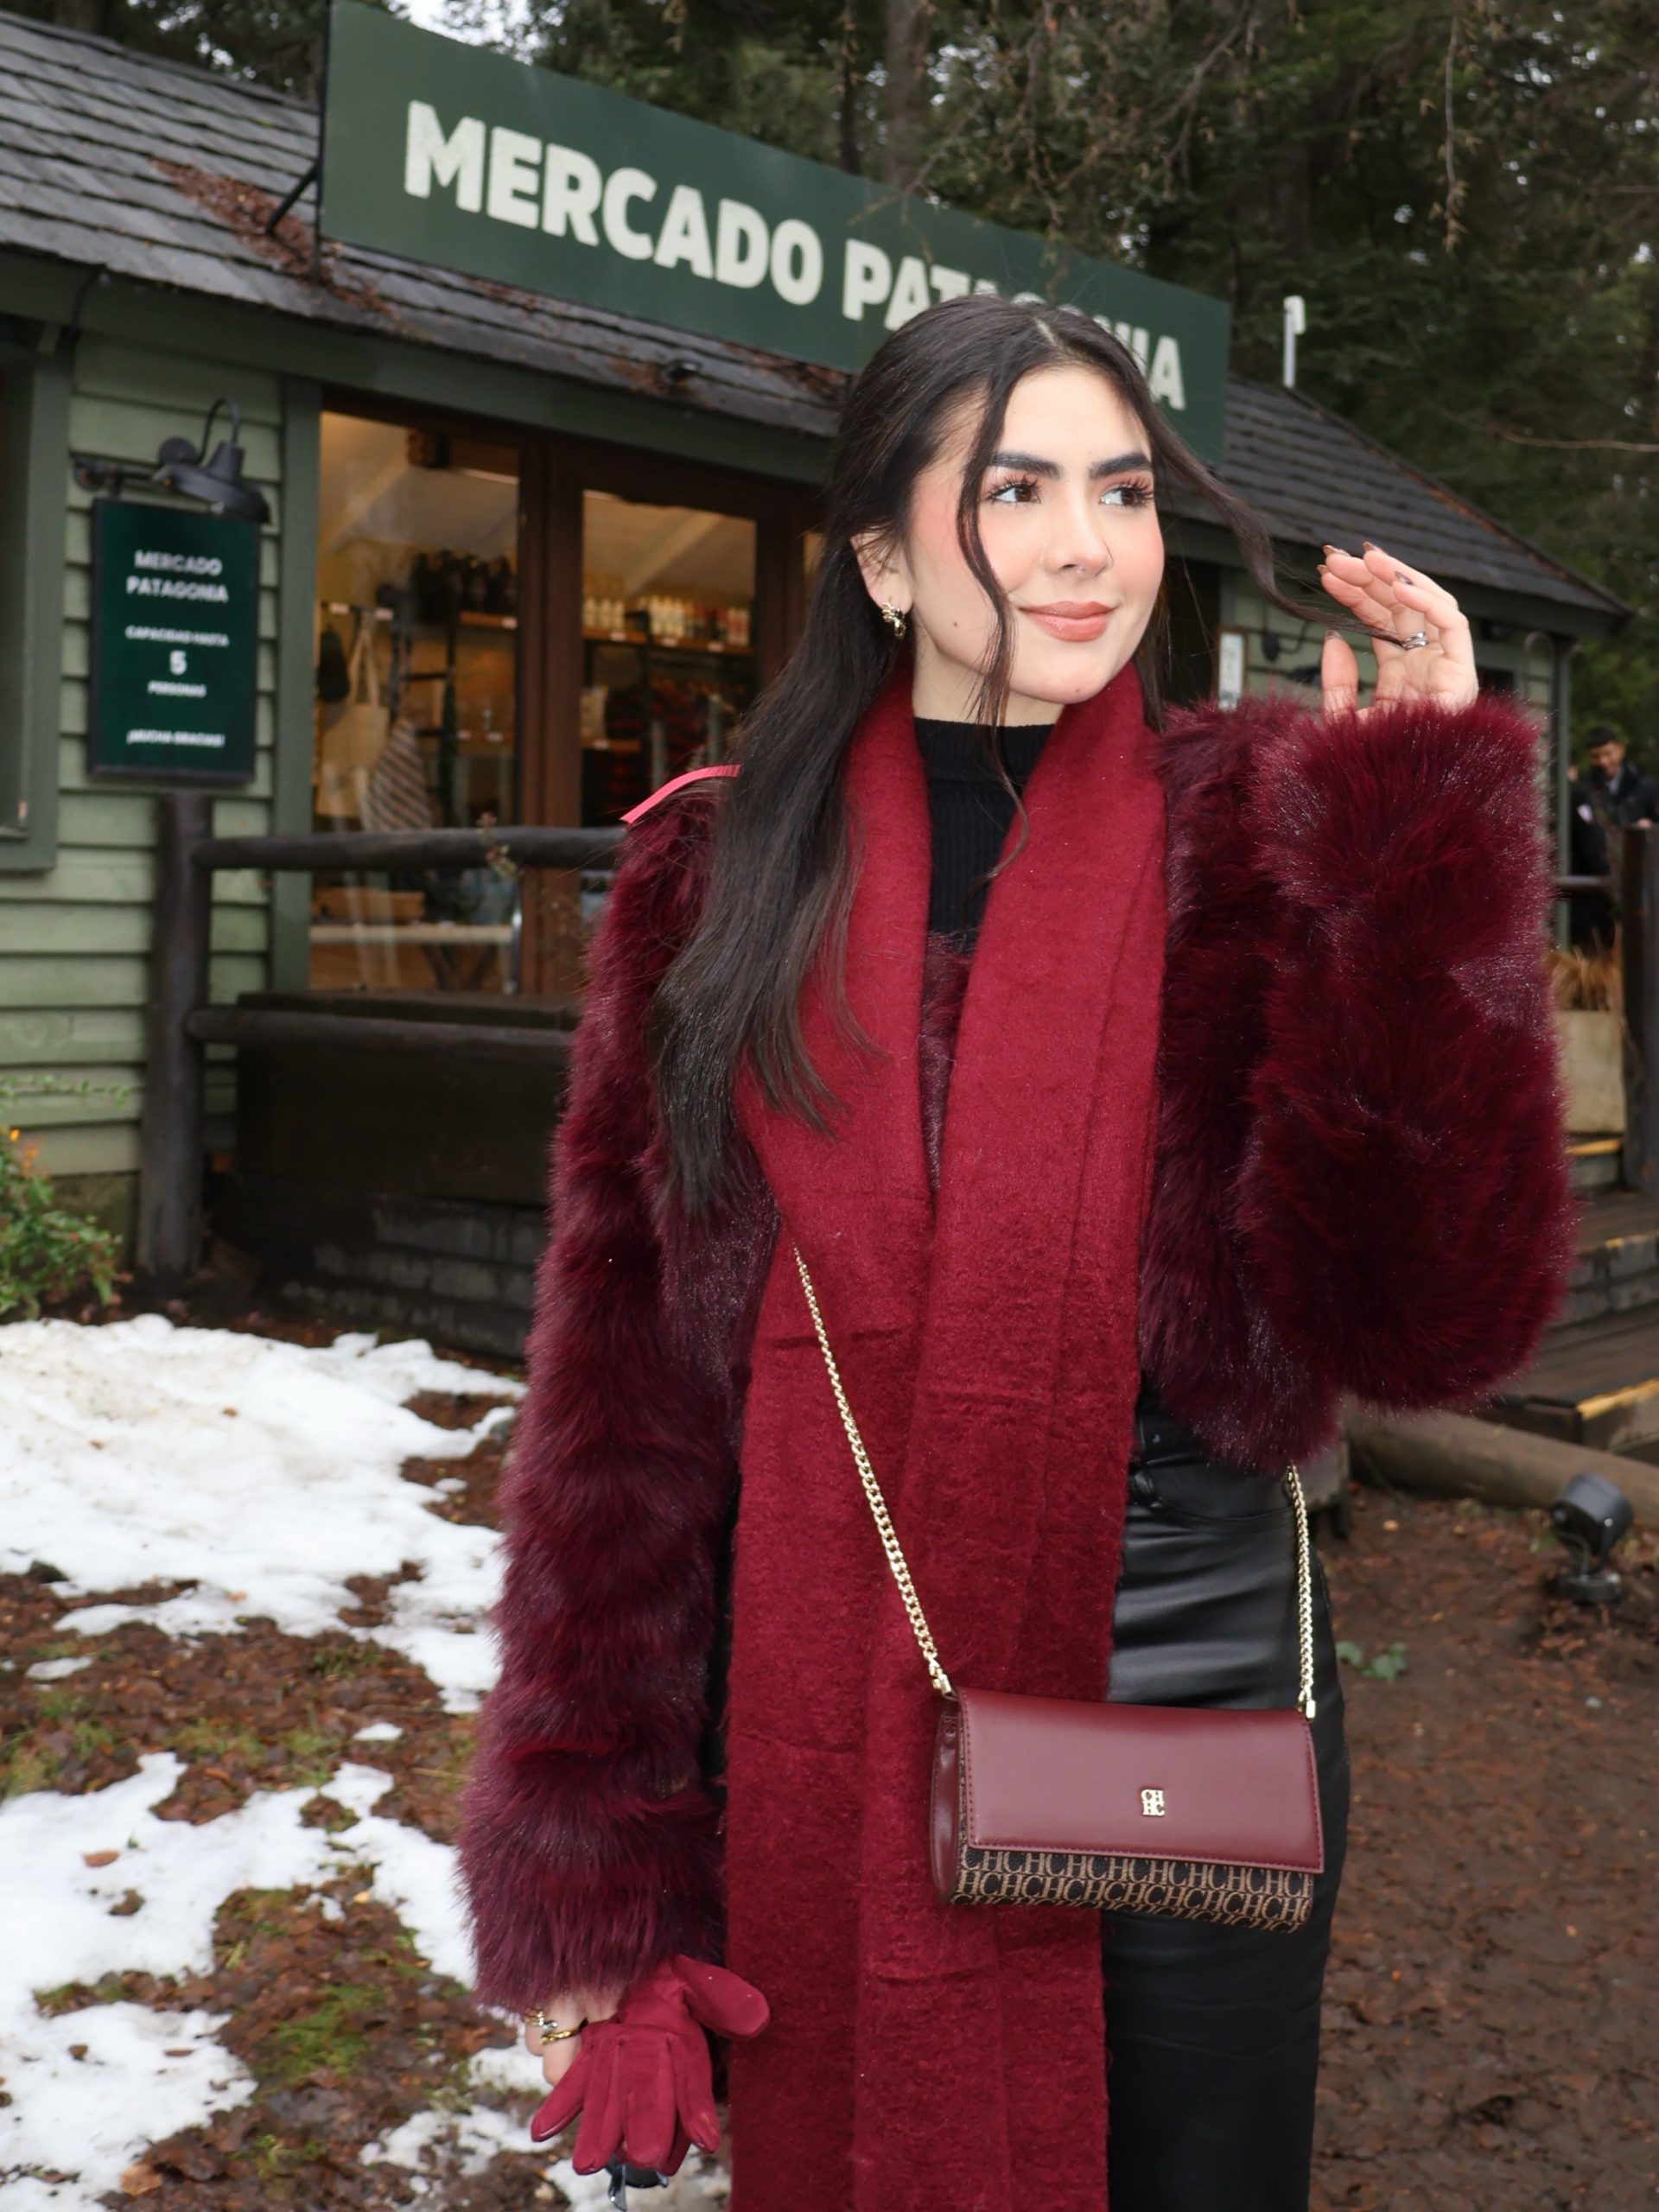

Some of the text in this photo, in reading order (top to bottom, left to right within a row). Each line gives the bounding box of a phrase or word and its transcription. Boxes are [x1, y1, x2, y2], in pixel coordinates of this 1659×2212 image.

[404, 99, 823, 305] MERCADO
[134, 550, 223, 576] MERCADO
[126, 575, 229, 603] PATAGONIA
